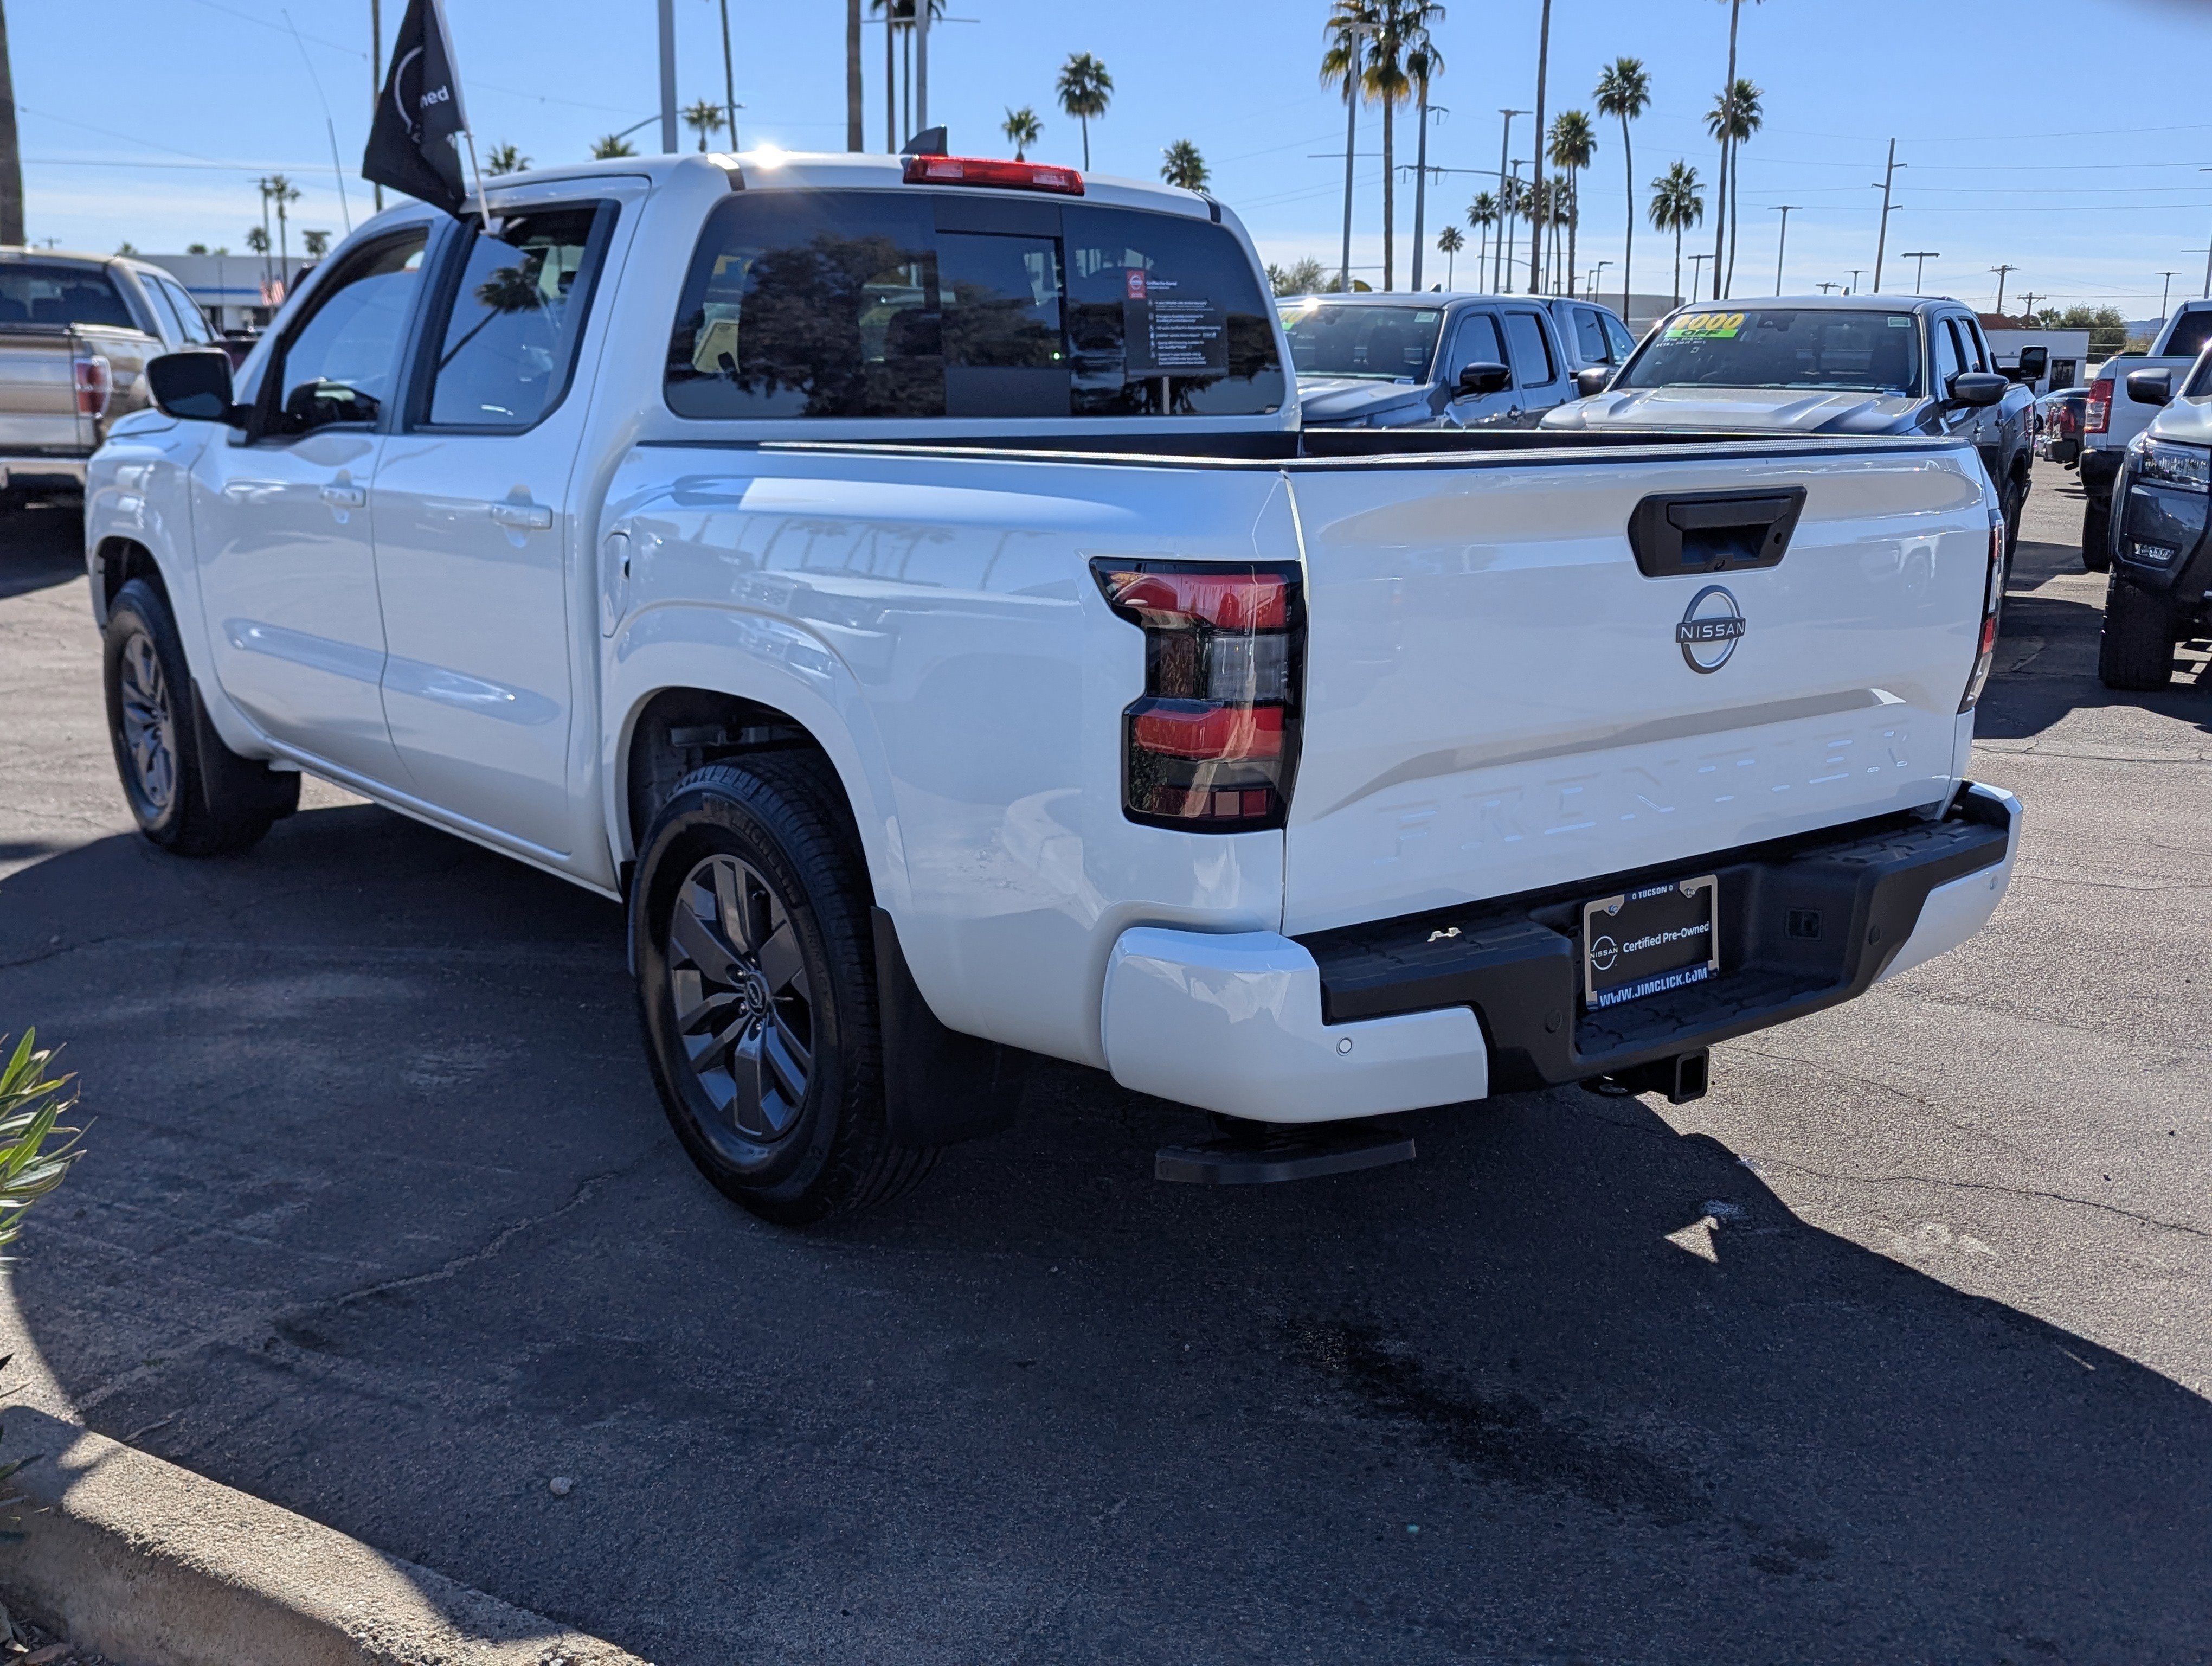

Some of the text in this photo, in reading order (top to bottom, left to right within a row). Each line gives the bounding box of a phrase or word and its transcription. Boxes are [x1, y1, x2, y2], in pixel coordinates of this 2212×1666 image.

[1680, 621, 1745, 639] NISSAN
[1638, 885, 1668, 899] TUCSON
[1623, 921, 1710, 953] Certified Pre-Owned
[1589, 946, 1618, 959] NISSAN
[1599, 967, 1708, 1007] WWW.JIMCLICK.COM
